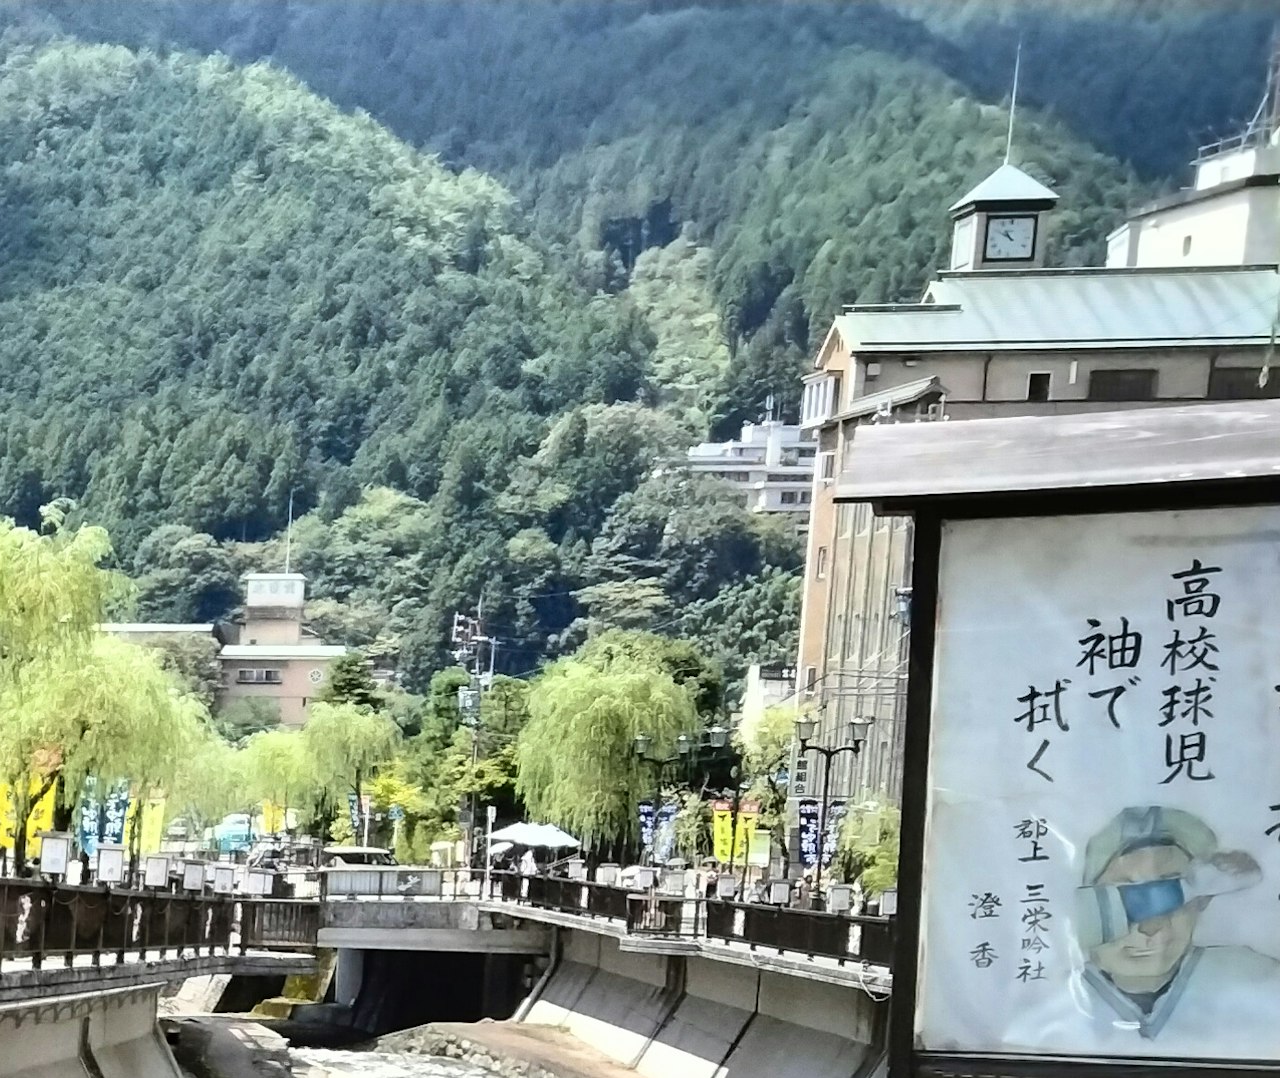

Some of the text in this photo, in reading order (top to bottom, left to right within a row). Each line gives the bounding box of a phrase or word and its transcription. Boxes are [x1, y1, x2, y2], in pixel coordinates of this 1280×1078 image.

[1075, 615, 1143, 729] 袖で
[1157, 558, 1223, 785] 高校球児
[1013, 678, 1074, 783] 拭く
[1012, 817, 1050, 864] 郡上
